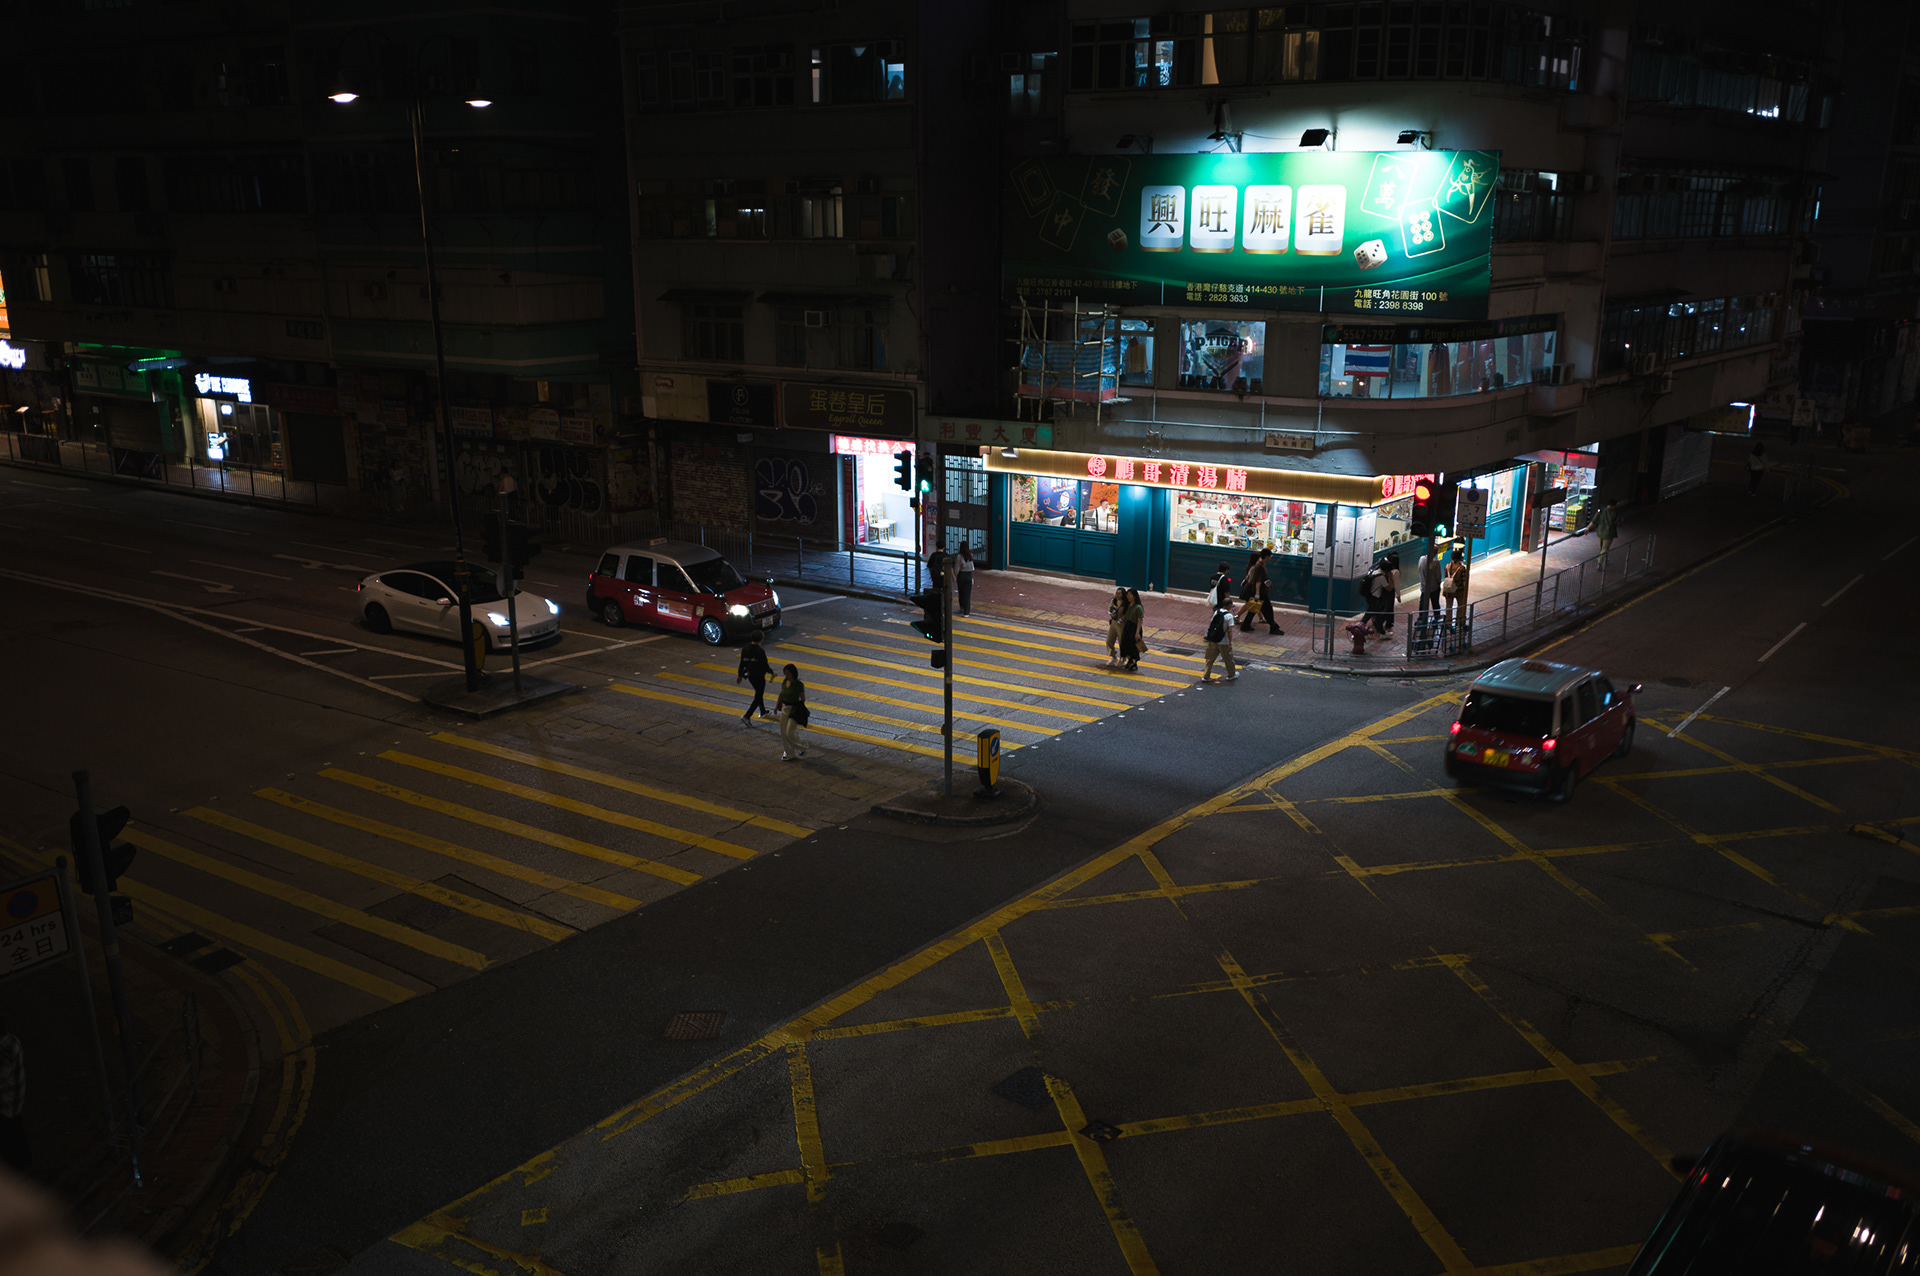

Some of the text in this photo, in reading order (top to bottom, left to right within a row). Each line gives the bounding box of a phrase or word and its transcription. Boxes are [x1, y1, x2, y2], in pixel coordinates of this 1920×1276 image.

[1091, 168, 1119, 201] 發
[1374, 164, 1405, 209] 八萬
[1054, 208, 1073, 236] 中
[1147, 192, 1335, 236] 興旺麻雀
[1054, 288, 1071, 297] 2111
[1186, 283, 1305, 295] 香港灣仔駱克道 414-430 號地下
[1209, 293, 1228, 302] 2828
[1229, 294, 1249, 303] 3633
[1354, 288, 1448, 302] 九龍旺角花園街 100 號
[1379, 300, 1400, 310] 2398
[1402, 301, 1424, 311] 8398
[1195, 335, 1249, 354] P.TIGER
[1343, 328, 1396, 341] 5547-7927
[1424, 328, 1449, 342] P.tiger
[1451, 327, 1465, 340] Gym
[809, 389, 886, 416] 蛋卷皇后
[828, 413, 885, 428] Eggroll Queen
[940, 421, 1037, 446] 利豐大廈
[1115, 458, 1248, 492] 鵬哥清湯腩
[1, 920, 57, 948] 24 hrs
[10, 936, 53, 967] 全日
